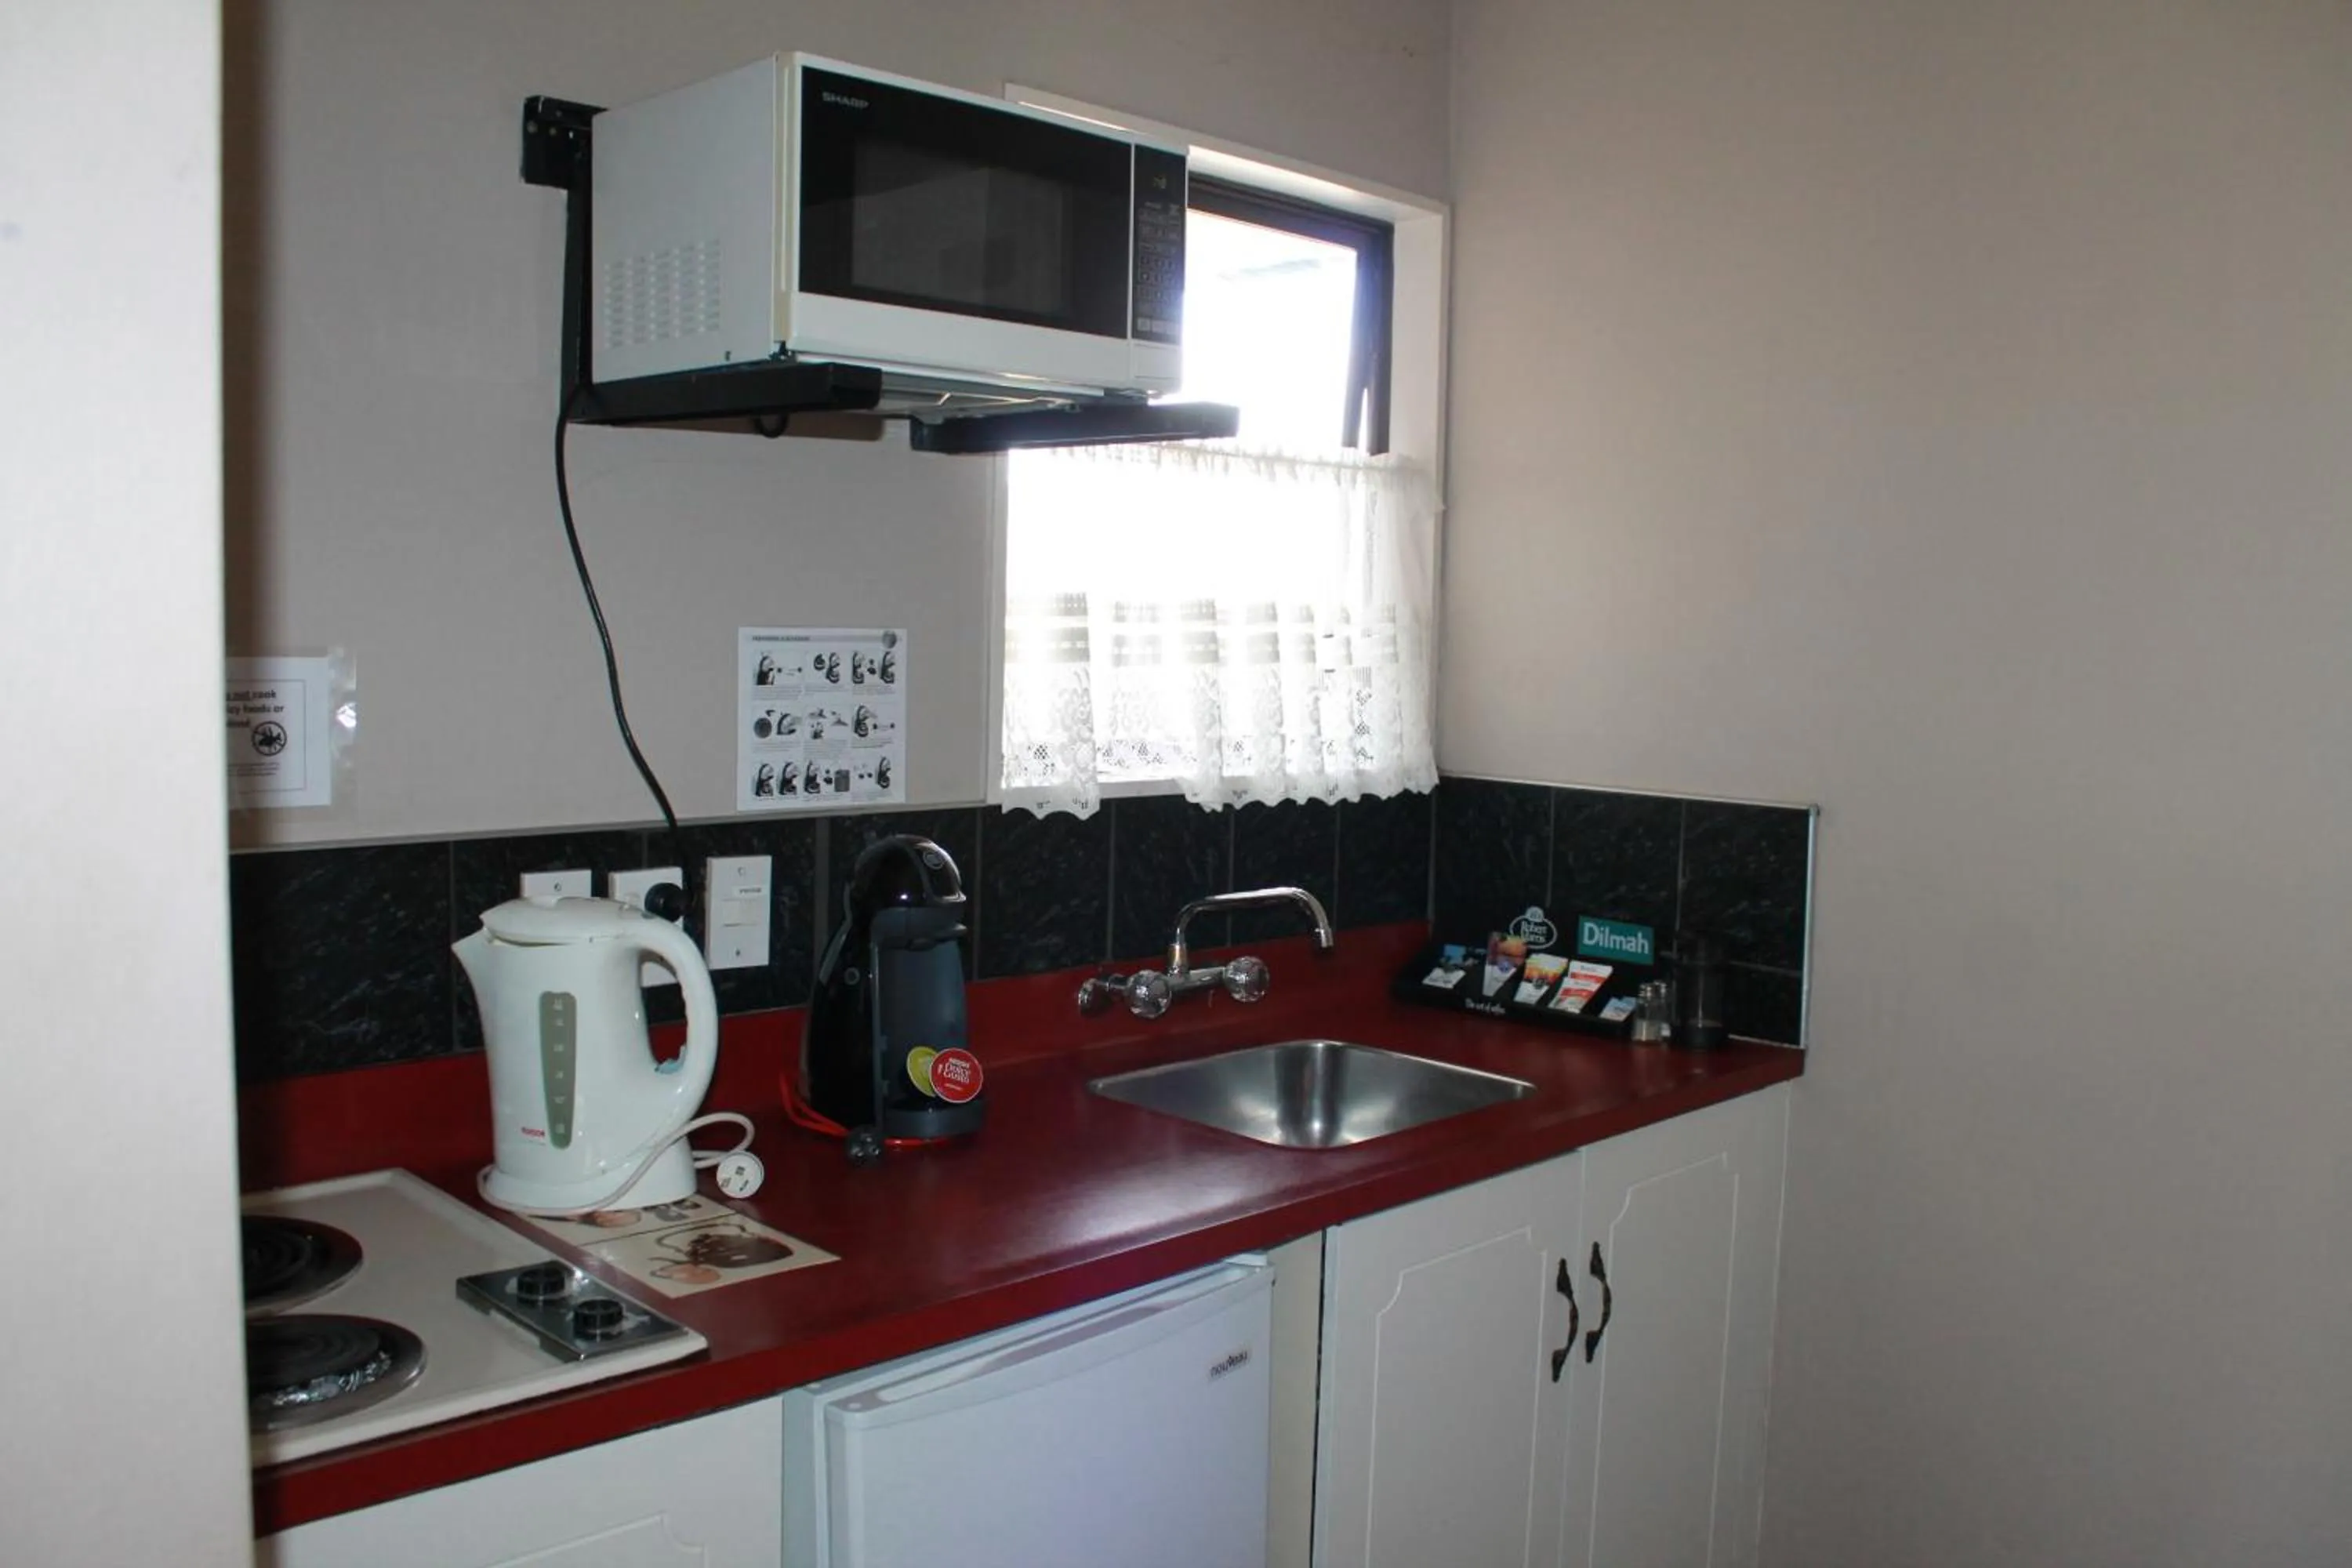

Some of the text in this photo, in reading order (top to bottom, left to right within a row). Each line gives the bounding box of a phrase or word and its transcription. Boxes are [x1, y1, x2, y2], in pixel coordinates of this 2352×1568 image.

[822, 91, 869, 109] SHARP
[252, 690, 276, 699] cook
[1582, 922, 1650, 954] Dilmah
